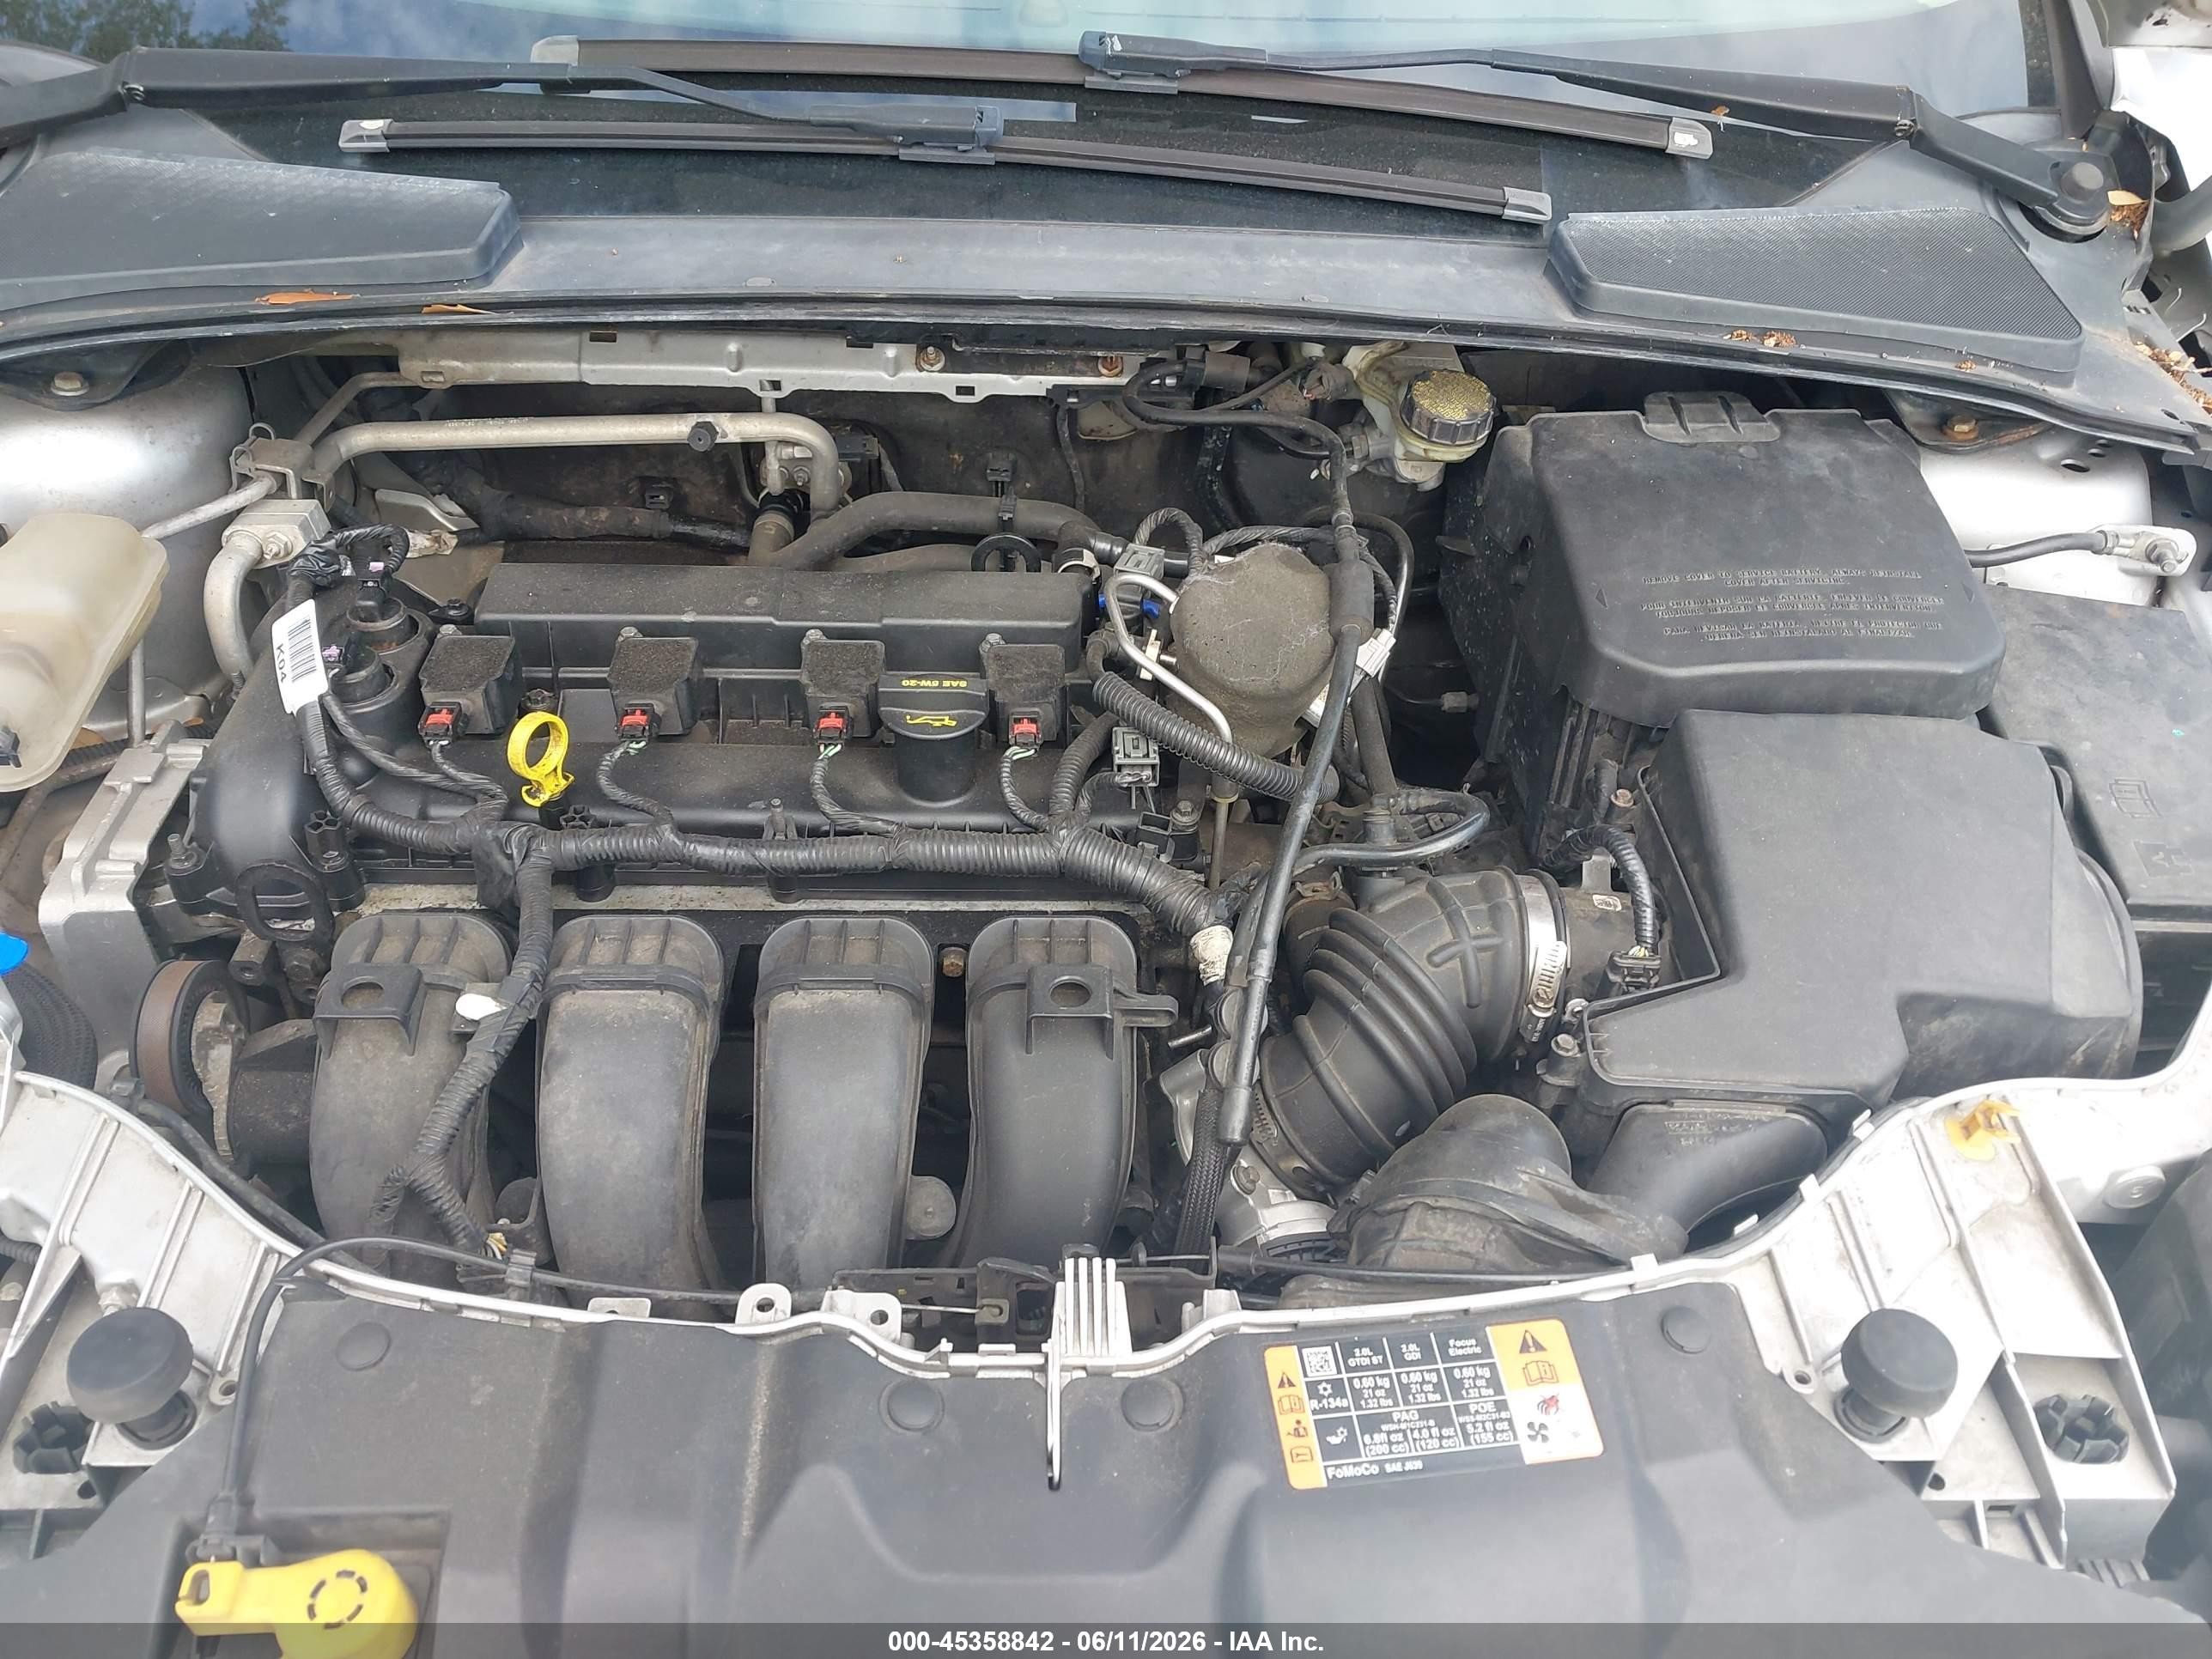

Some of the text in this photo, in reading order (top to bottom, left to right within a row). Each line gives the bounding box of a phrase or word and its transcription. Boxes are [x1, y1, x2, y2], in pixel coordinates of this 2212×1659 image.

[1401, 1343, 1420, 1353] 2.0L
[1449, 1338, 1477, 1348] Focus
[1353, 1347, 1374, 1357] 2.0L
[1404, 1352, 1422, 1361] GDI
[1448, 1346, 1482, 1357] Electric
[1347, 1357, 1371, 1367] GTDI
[1401, 1370, 1438, 1384] 0.60 kg
[1453, 1365, 1491, 1379] 0.60 kg
[1352, 1376, 1391, 1389] 0.60 kg
[1410, 1383, 1435, 1394] 21 oz
[1462, 1378, 1487, 1389] 21 oz
[1362, 1389, 1387, 1399] 21 oz
[1408, 1393, 1442, 1404] 1.32 lbs
[1462, 1387, 1495, 1398] 1.32 lbs
[1310, 1397, 1348, 1412] R-134a
[1360, 1397, 1394, 1409] 1.32 lbs
[1468, 1401, 1497, 1414] POE
[1392, 1410, 1419, 1423] PAG
[1413, 1426, 1455, 1440] 4.0 fl oz
[1466, 1420, 1510, 1434] 5.2 fl oz
[1389, 1432, 1404, 1442] oz
[1470, 1431, 1514, 1446] (155 cc)
[1365, 1441, 1409, 1458] (200 cc)
[1415, 1437, 1460, 1452] (120 cc)
[1326, 1462, 1380, 1480] FoMoCo
[1384, 1462, 1403, 1474] SAE
